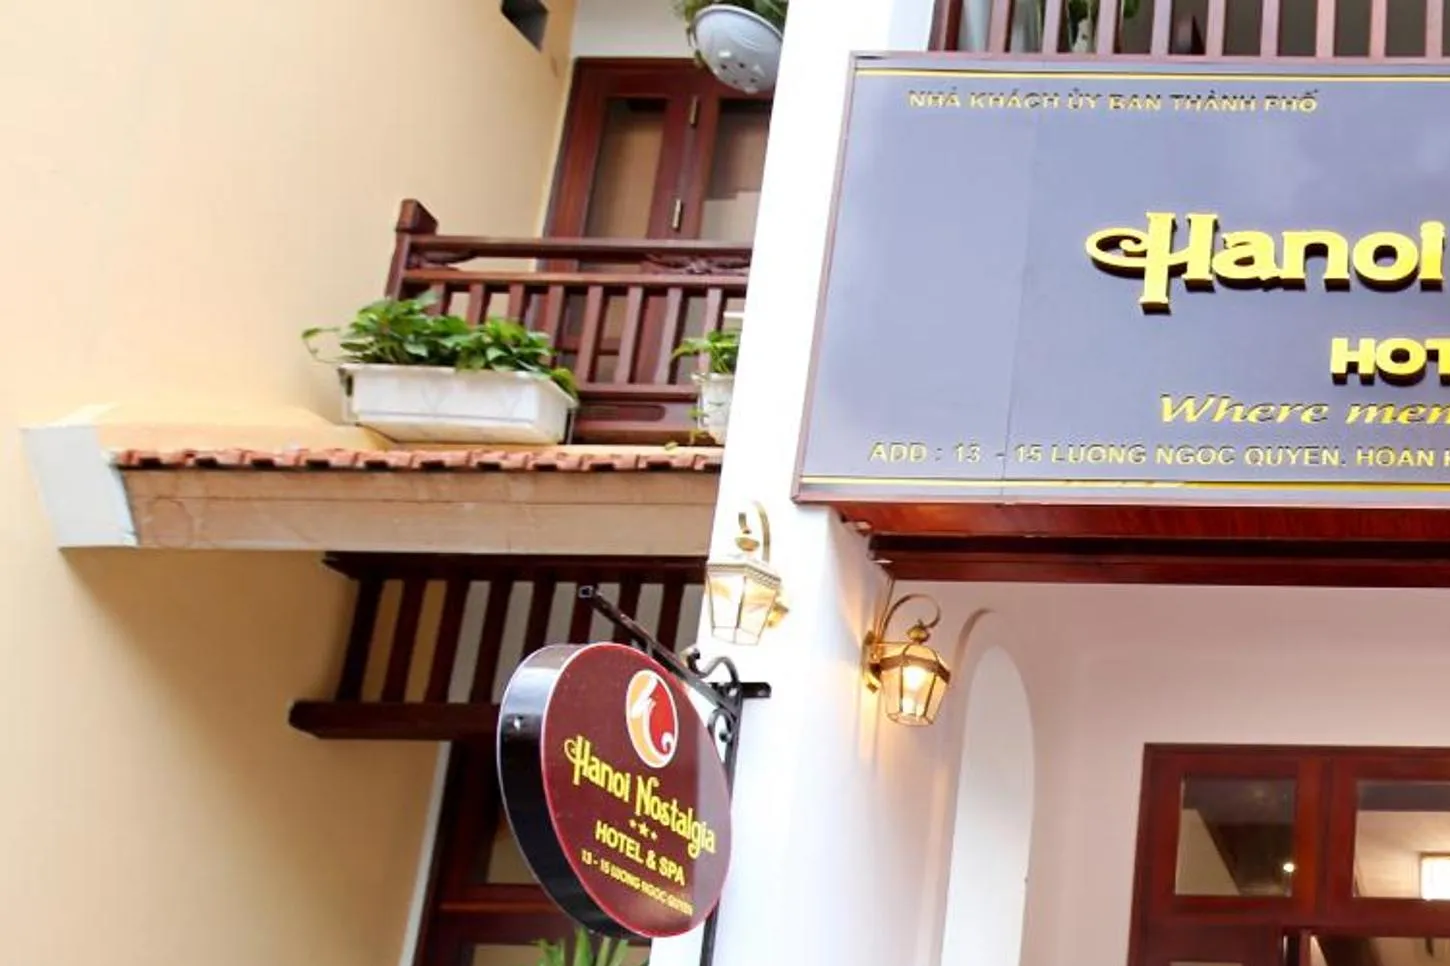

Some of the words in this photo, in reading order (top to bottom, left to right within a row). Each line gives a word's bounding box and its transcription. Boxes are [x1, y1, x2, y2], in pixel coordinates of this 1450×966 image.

[1109, 93, 1161, 111] BAN
[1085, 211, 1446, 314] Hanoi
[1160, 393, 1329, 425] Where
[869, 441, 927, 463] ADD
[954, 443, 981, 464] 13
[1014, 443, 1042, 464] 15
[1051, 443, 1147, 465] LUONG
[1154, 444, 1235, 466] NGOC
[1356, 446, 1435, 468] HOAN
[564, 735, 631, 803] Hanoi
[635, 775, 716, 859] Nostalgia
[595, 820, 643, 864] HOTEL
[646, 850, 657, 871] &
[659, 856, 685, 886] SPA
